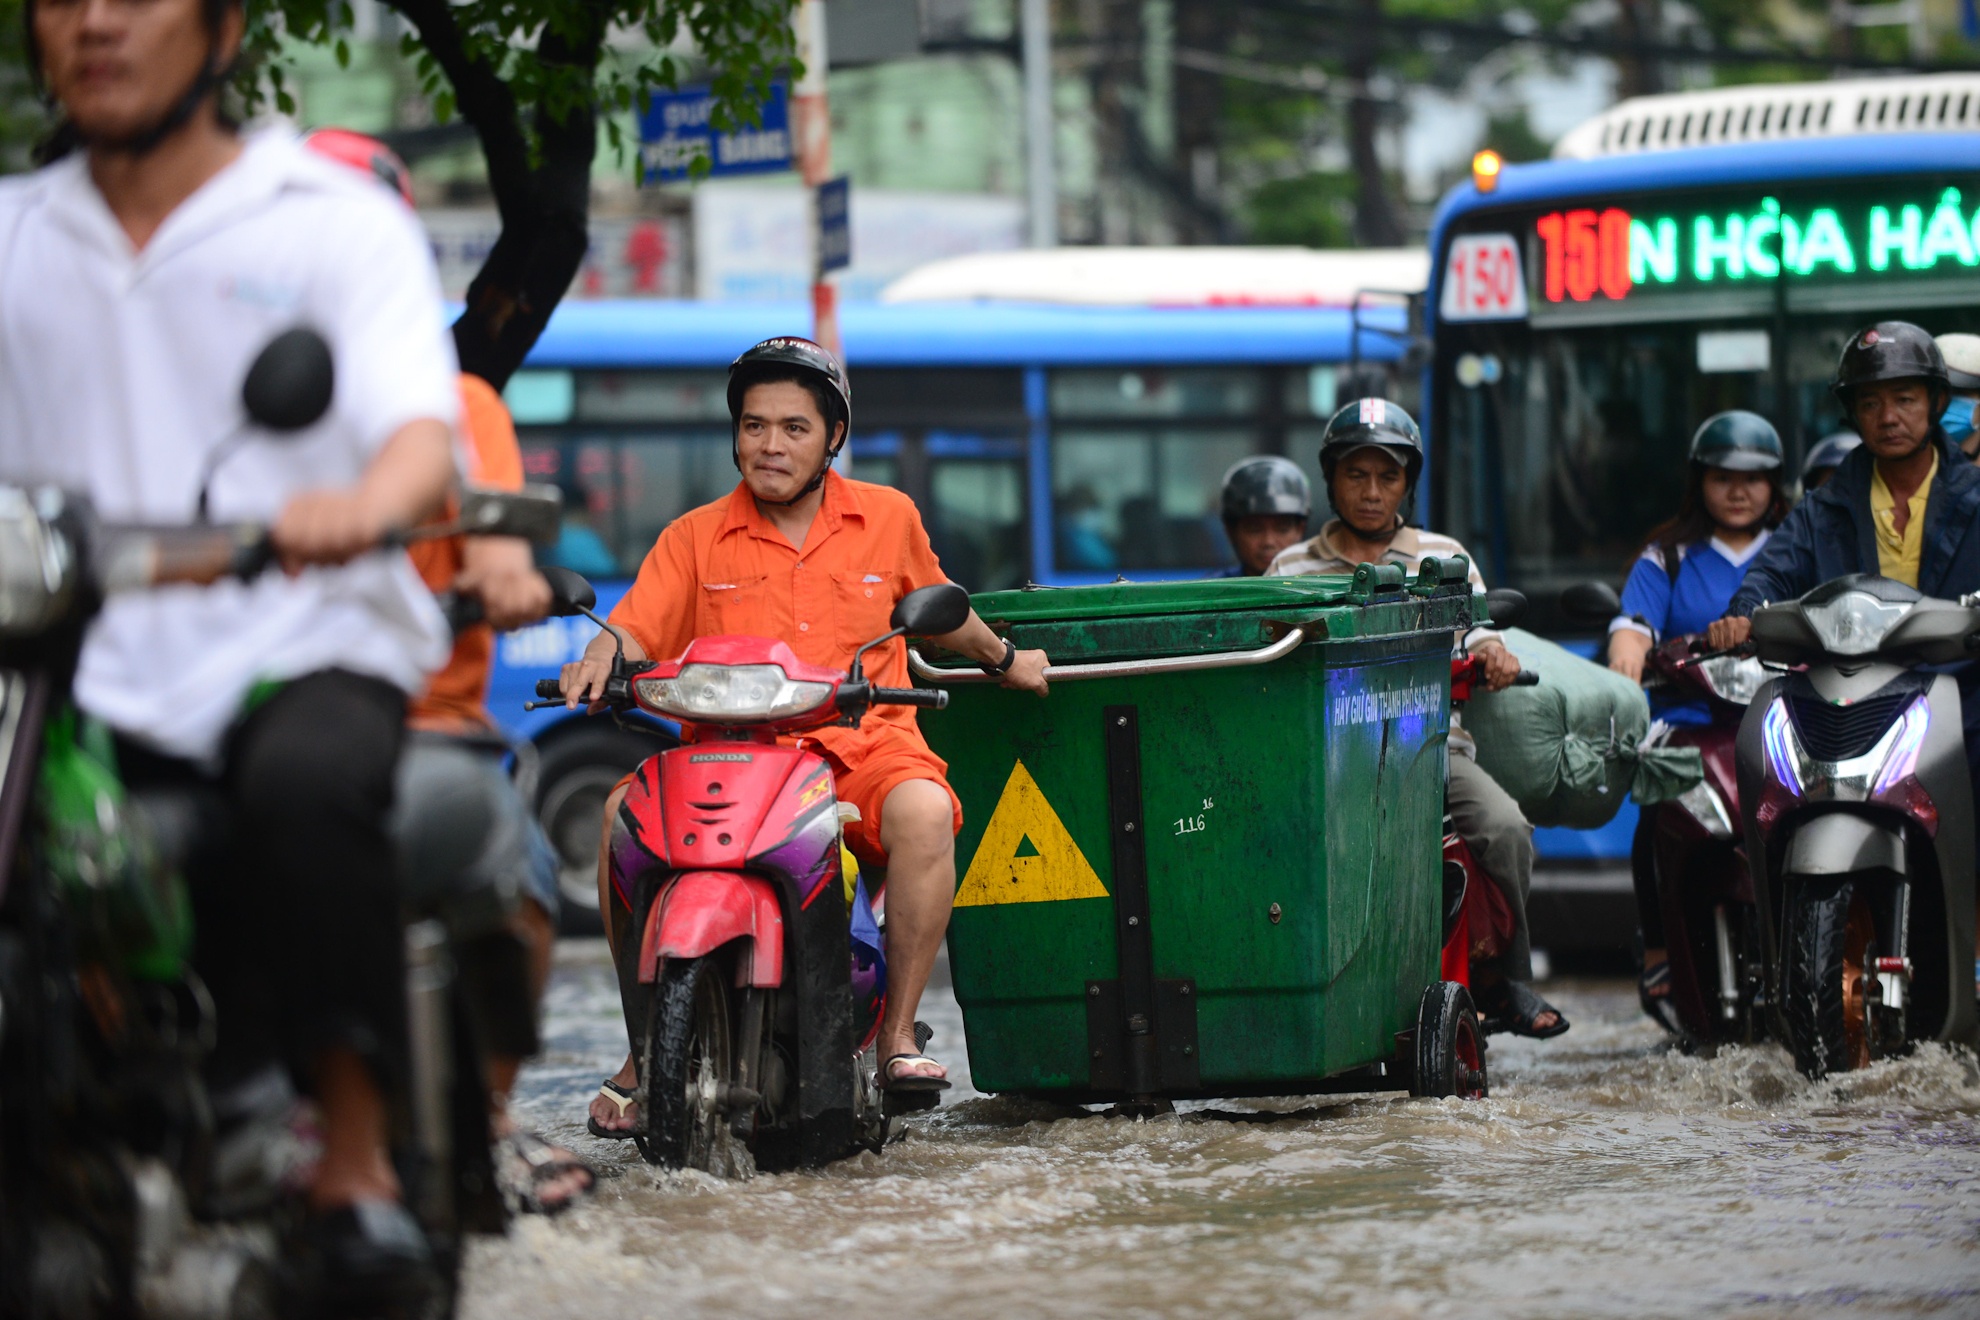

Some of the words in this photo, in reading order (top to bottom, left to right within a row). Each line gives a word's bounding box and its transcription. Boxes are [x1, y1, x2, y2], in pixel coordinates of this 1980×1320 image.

[1537, 207, 1632, 302] 150
[1869, 186, 1980, 272] HẢ
[1454, 247, 1516, 311] 150
[1365, 686, 1378, 723] GÌN
[1379, 683, 1401, 720] THÀNH
[1402, 676, 1414, 717] PHỐ
[691, 753, 750, 762] HONDA
[1203, 796, 1214, 810] 16
[1173, 813, 1206, 836] 116
